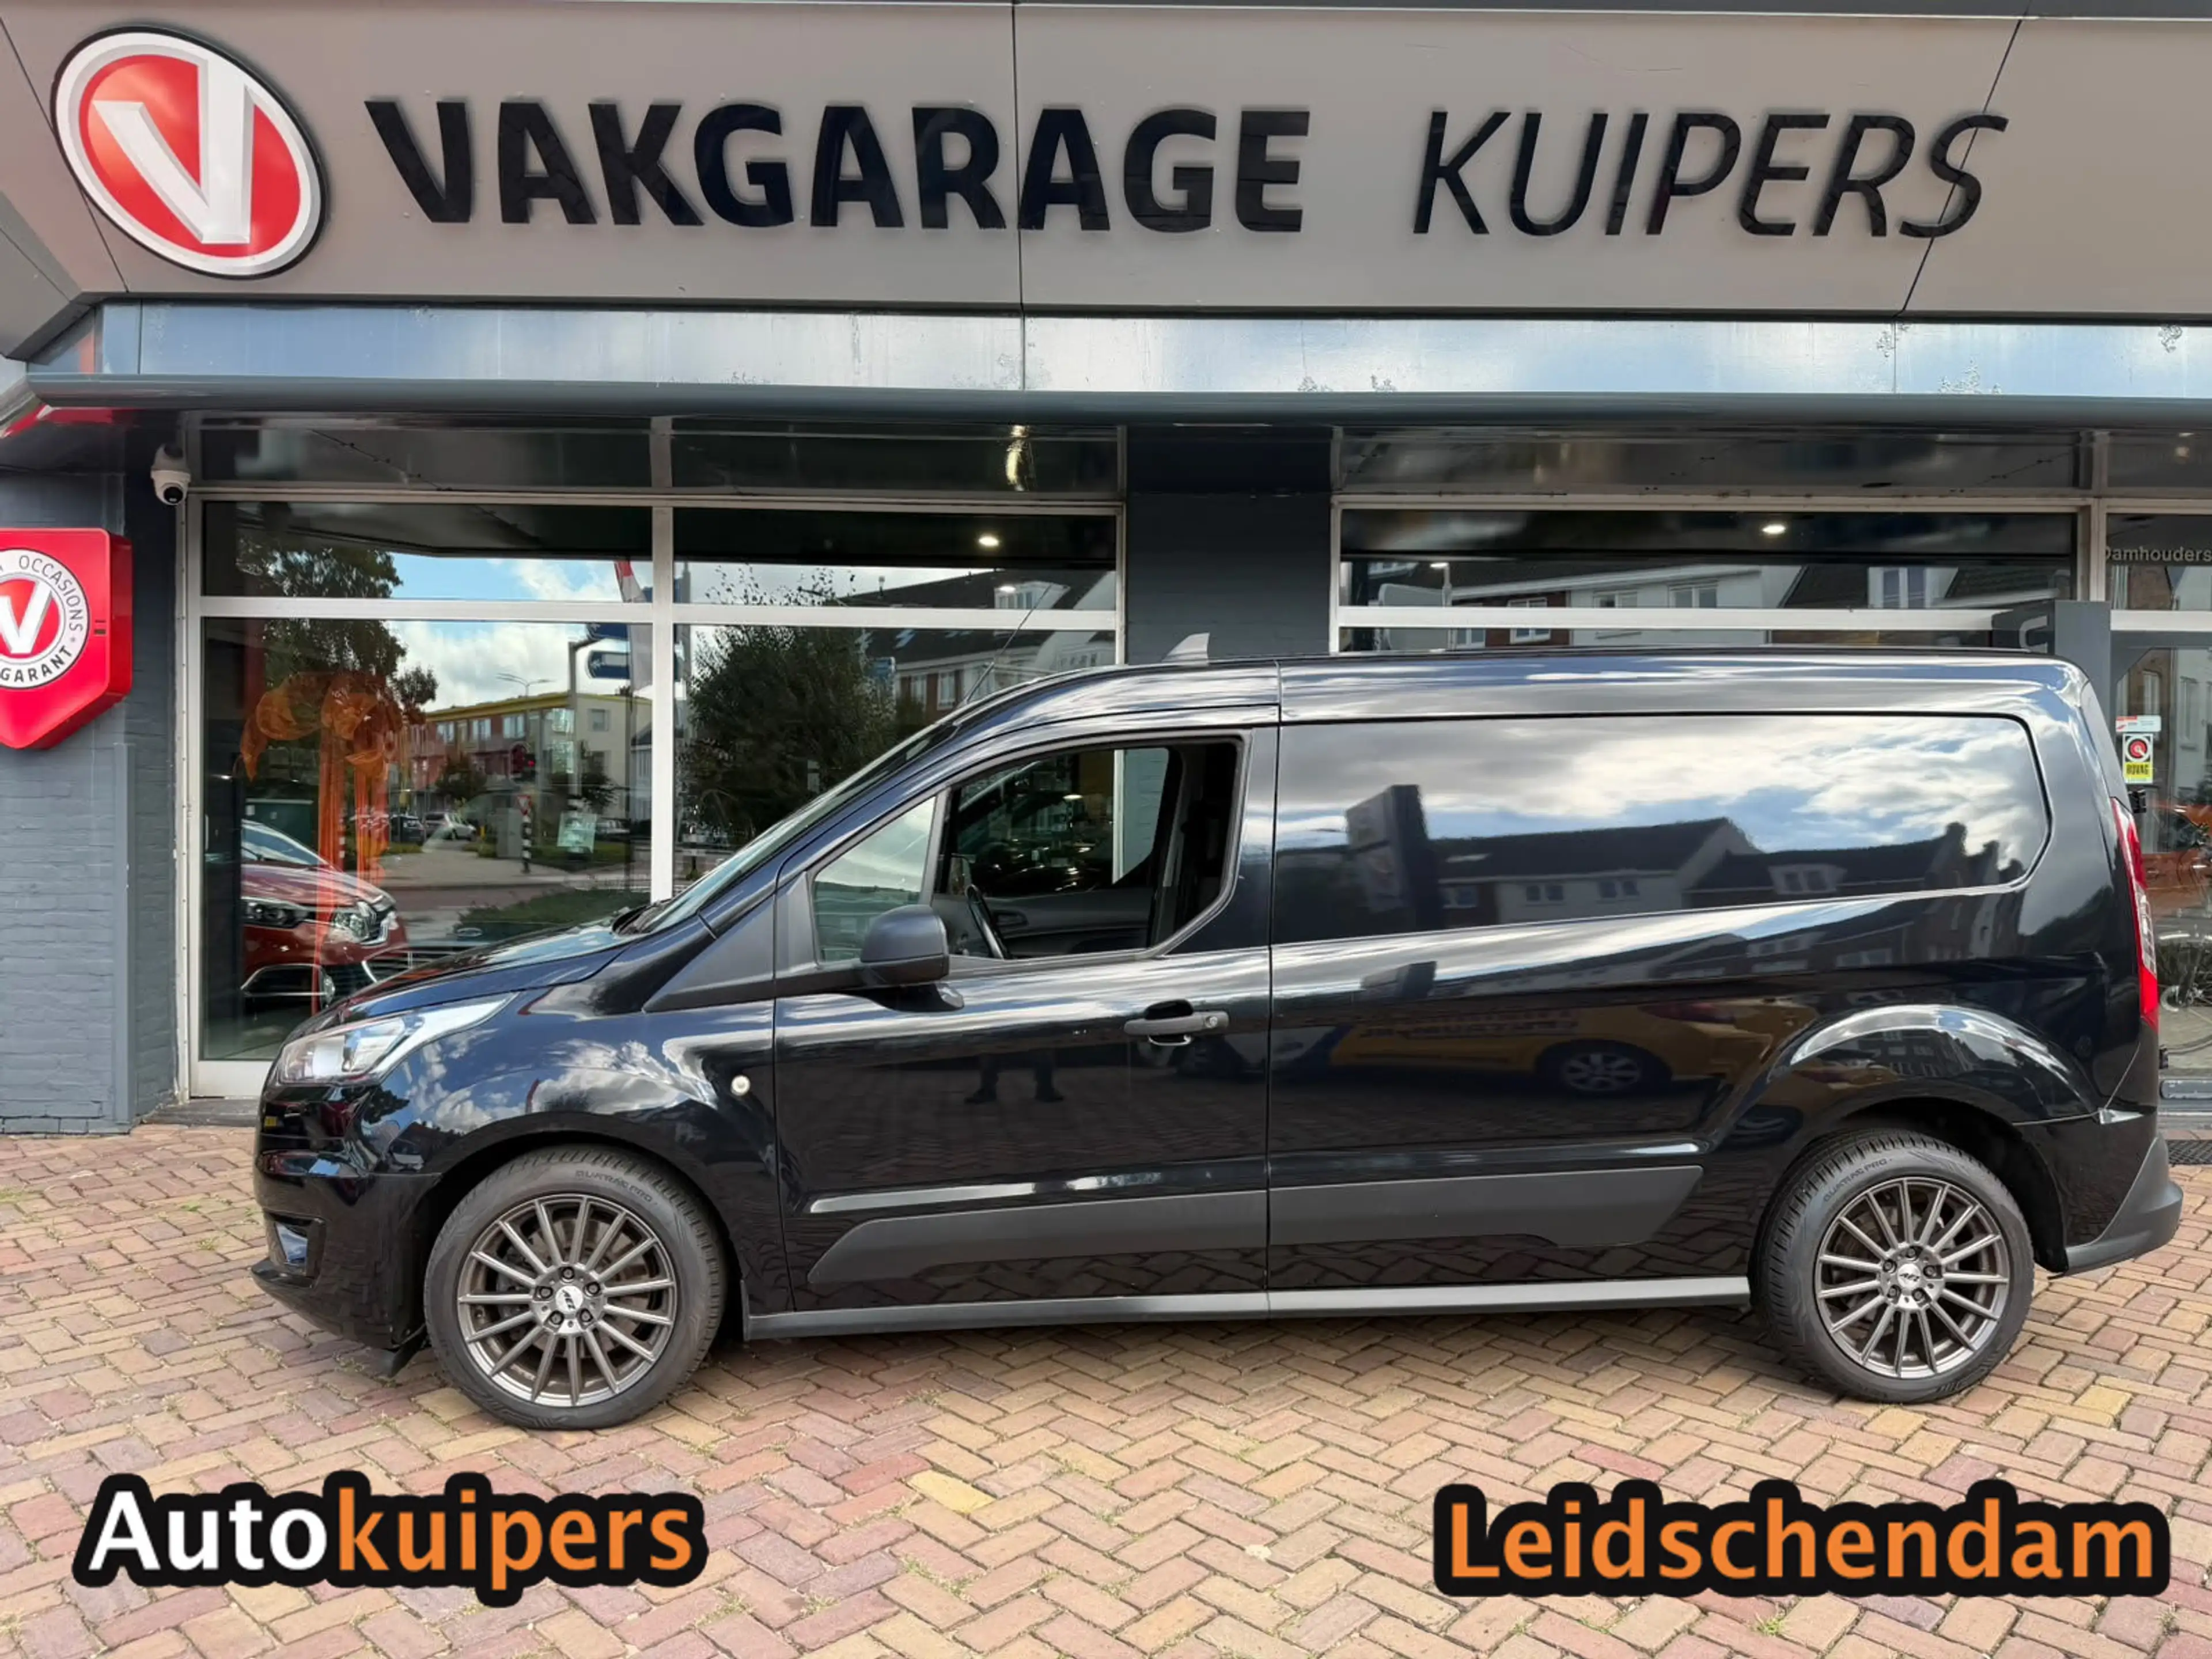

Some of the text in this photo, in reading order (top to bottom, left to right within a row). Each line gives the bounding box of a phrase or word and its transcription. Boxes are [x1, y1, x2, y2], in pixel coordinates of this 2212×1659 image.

[365, 101, 2008, 237] VAKGARAGE KUIPERS
[19, 555, 84, 632] OCCASIONS
[0, 645, 73, 683] GARANT
